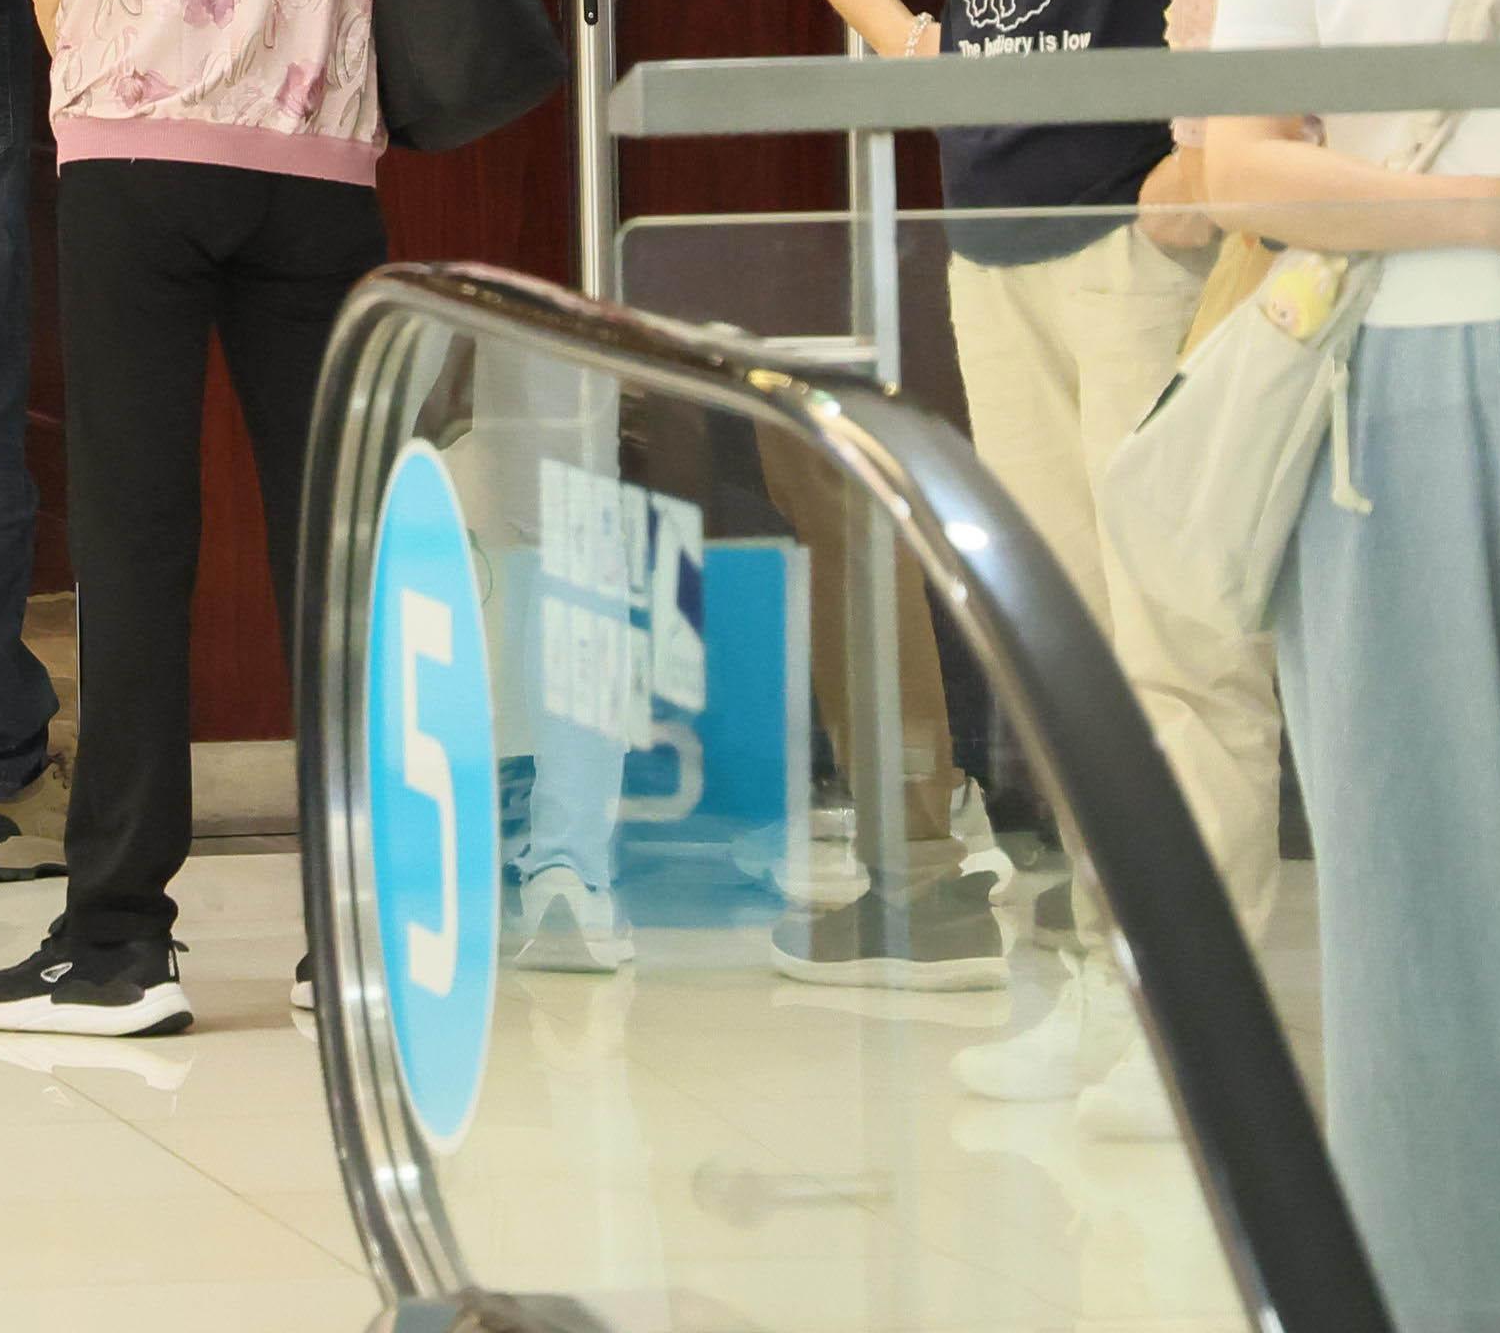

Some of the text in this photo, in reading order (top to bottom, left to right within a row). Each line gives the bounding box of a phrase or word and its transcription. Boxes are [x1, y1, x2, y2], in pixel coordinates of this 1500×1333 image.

[958, 39, 982, 57] The
[1039, 31, 1058, 53] is
[1063, 29, 1092, 50] low
